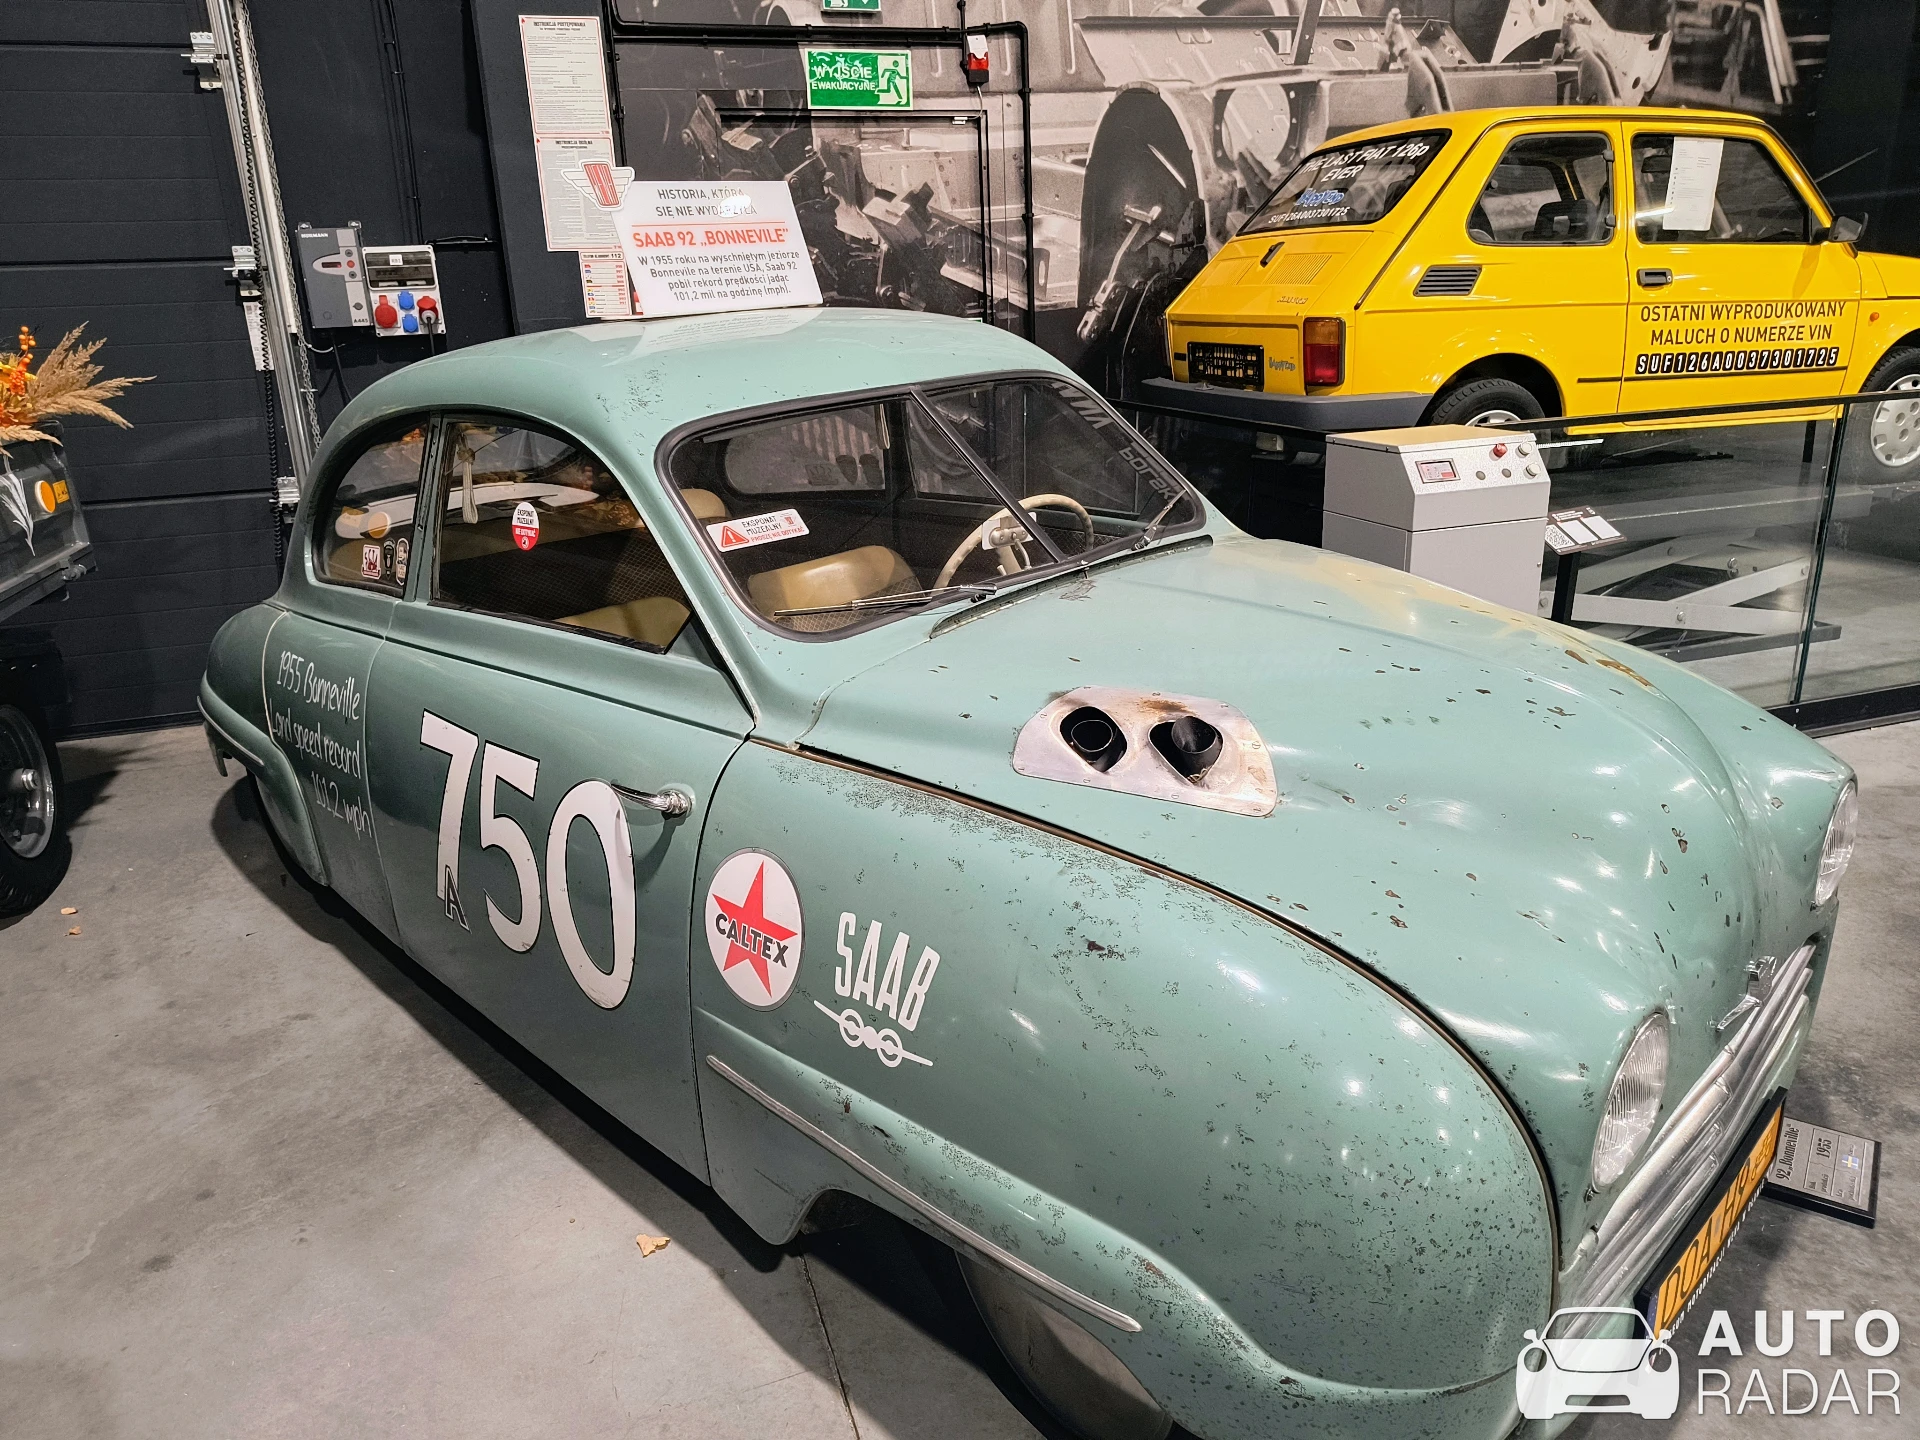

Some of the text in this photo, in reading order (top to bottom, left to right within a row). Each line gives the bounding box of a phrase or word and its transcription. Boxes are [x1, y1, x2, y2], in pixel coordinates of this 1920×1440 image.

[811, 81, 876, 90] EWAKUACYJNE
[1299, 143, 1431, 175] THE LAST FIAT 126p
[1321, 165, 1364, 182] EVER
[657, 186, 744, 200] HISTORIA, KTÓRA
[655, 206, 675, 218] SIĘ
[676, 206, 694, 216] NIE
[632, 231, 675, 248] SAAB
[677, 231, 697, 246] 92
[638, 250, 800, 266] W 1955 roku na wyschniętym jeziorze
[650, 261, 798, 278] Bonnevile na terenie USA, Saab 92
[693, 275, 723, 288] rekord
[725, 273, 766, 289] prędkości
[767, 273, 790, 286] jadąc
[674, 290, 700, 302] 101,2
[700, 288, 715, 300] mil
[717, 290, 729, 299] na
[729, 285, 763, 300] godzinę
[1640, 301, 1846, 322] OSTATNI WYPRODUKOWANY
[1651, 324, 1833, 346] MALUCH O NUMERZE VIN
[1637, 348, 1838, 373] SUF126A0037301725
[741, 515, 778, 528] EKSPONAT
[746, 522, 782, 535] MUZEALNY
[750, 533, 772, 542] PROSZĘ
[772, 531, 782, 540] NIE
[276, 650, 361, 720] 1955 Bonneville
[269, 698, 361, 779] Land speed record
[343, 796, 373, 840] mph
[420, 708, 637, 1011] 750
[715, 913, 789, 968] CALTEX
[834, 911, 941, 1032] SAAB
[1816, 1137, 1833, 1159] 1955
[1776, 1168, 1792, 1181] 92
[1660, 1216, 1713, 1330] DOA
